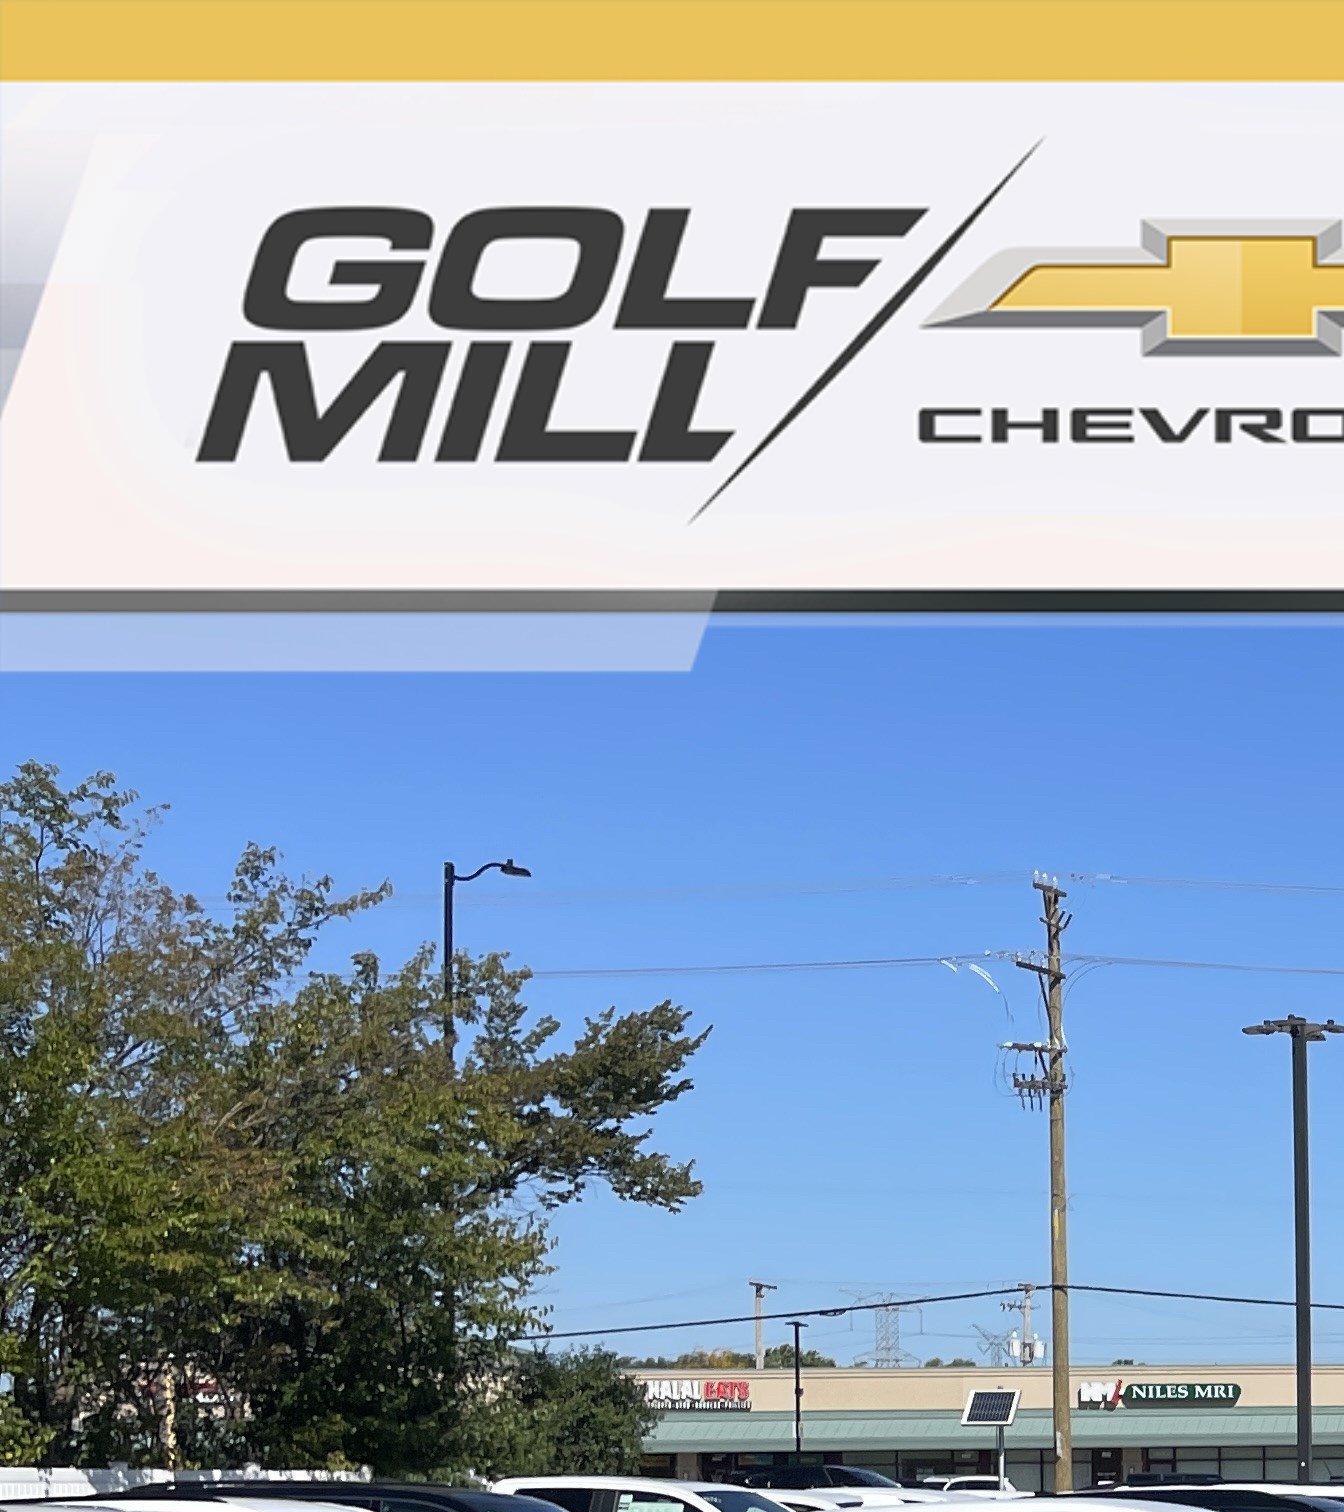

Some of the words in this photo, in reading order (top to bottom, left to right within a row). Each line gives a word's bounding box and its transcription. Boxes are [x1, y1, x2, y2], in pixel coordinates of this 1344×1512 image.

[646, 1380, 701, 1400] HALAL
[703, 1380, 750, 1400] EATS
[1132, 1385, 1189, 1399] NILES
[1194, 1385, 1235, 1399] MRI
